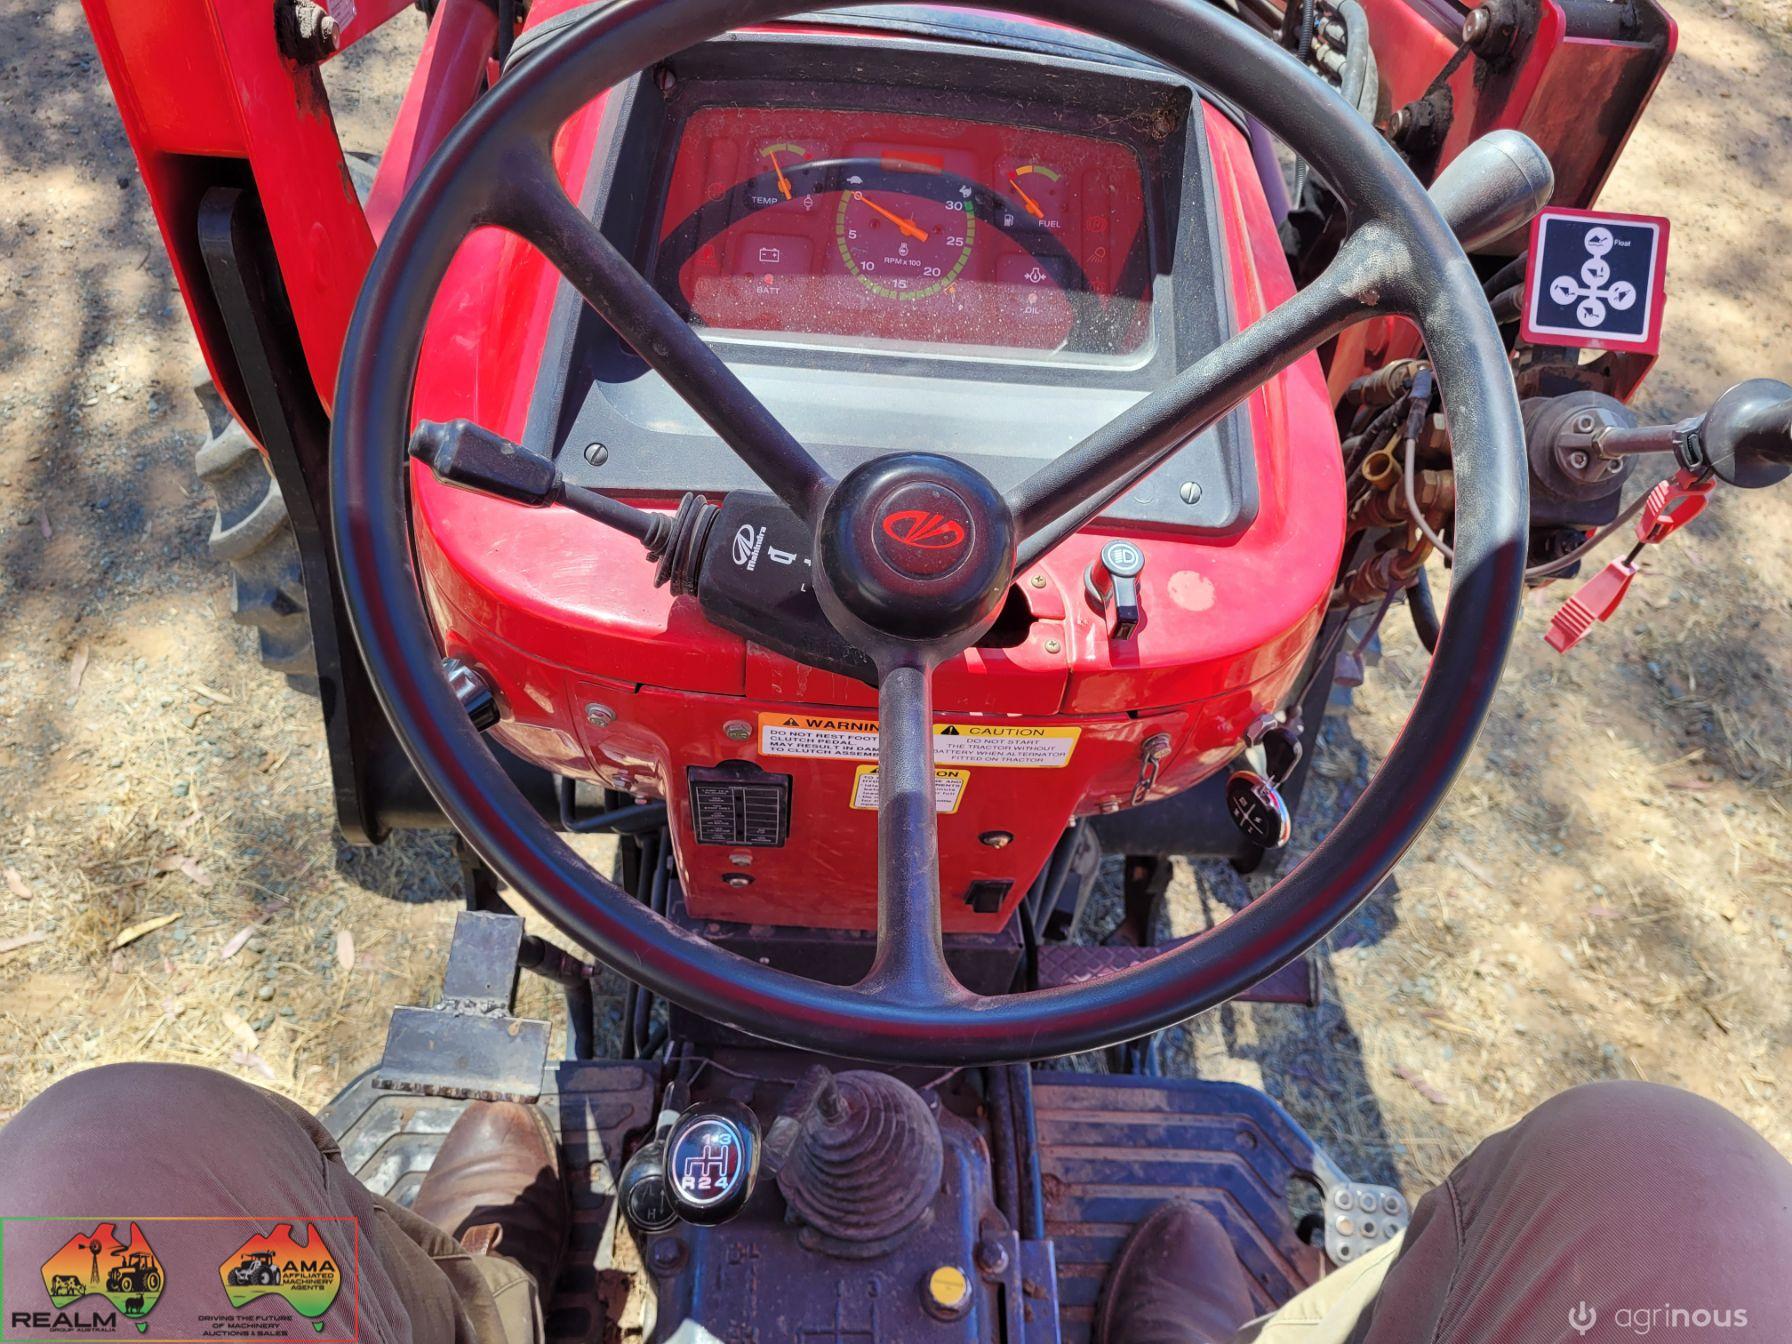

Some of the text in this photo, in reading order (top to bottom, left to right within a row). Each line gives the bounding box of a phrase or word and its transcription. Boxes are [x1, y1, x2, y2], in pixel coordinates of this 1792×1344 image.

[752, 196, 778, 205] TEMP
[945, 201, 963, 211] 30
[1038, 220, 1061, 228] FUEL
[848, 229, 857, 239] 5
[946, 236, 964, 246] 25
[861, 261, 875, 271] 10
[884, 257, 902, 265] RPM
[923, 267, 941, 276] 20
[892, 279, 908, 289] 15
[756, 286, 780, 294] BATT
[806, 719, 880, 731] WARNIN
[969, 727, 1045, 736] CAUTION
[720, 1134, 731, 1144] 3
[681, 1177, 728, 1190] R 2 4
[647, 1208, 656, 1220] H
